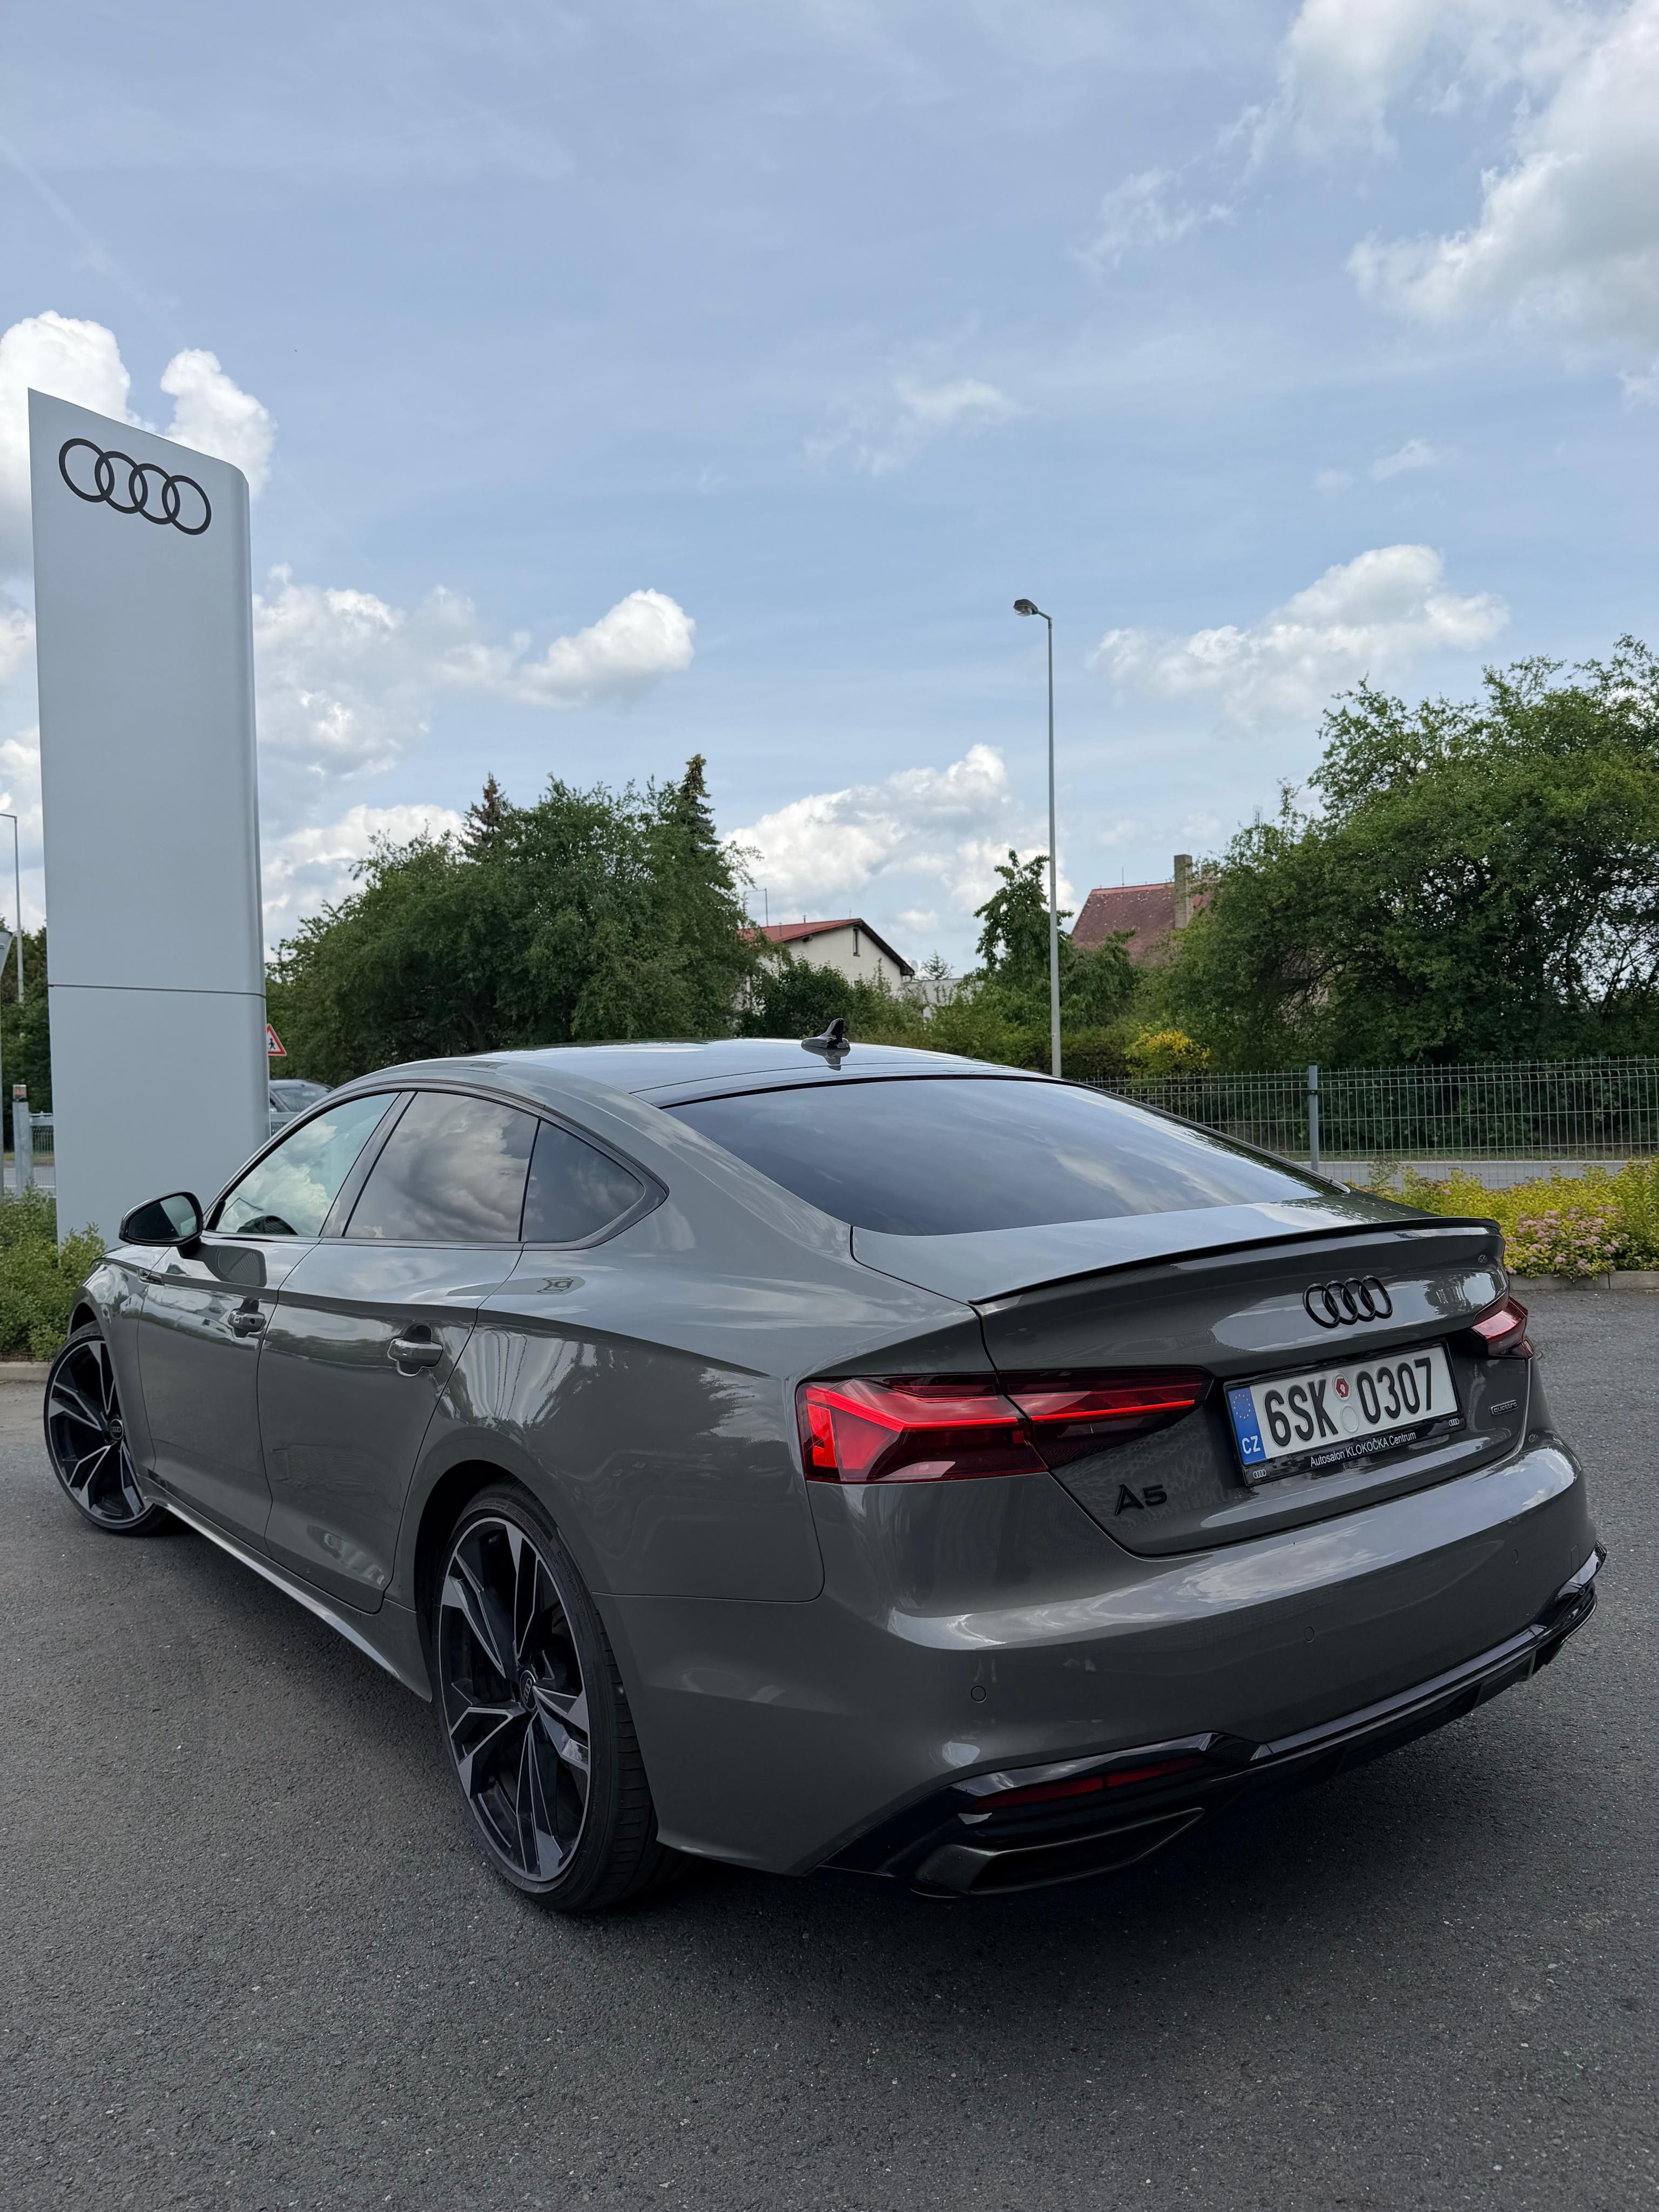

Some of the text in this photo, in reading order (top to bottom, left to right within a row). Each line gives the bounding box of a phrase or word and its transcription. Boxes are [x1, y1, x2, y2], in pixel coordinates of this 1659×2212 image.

[1265, 1357, 1431, 1447] 6SK 0307
[1493, 1402, 1518, 1413] quattro
[1242, 1435, 1260, 1454] CZ
[1311, 1432, 1417, 1467] Autosalon KLOKOČKA Centrum
[1115, 1484, 1167, 1515] A5
